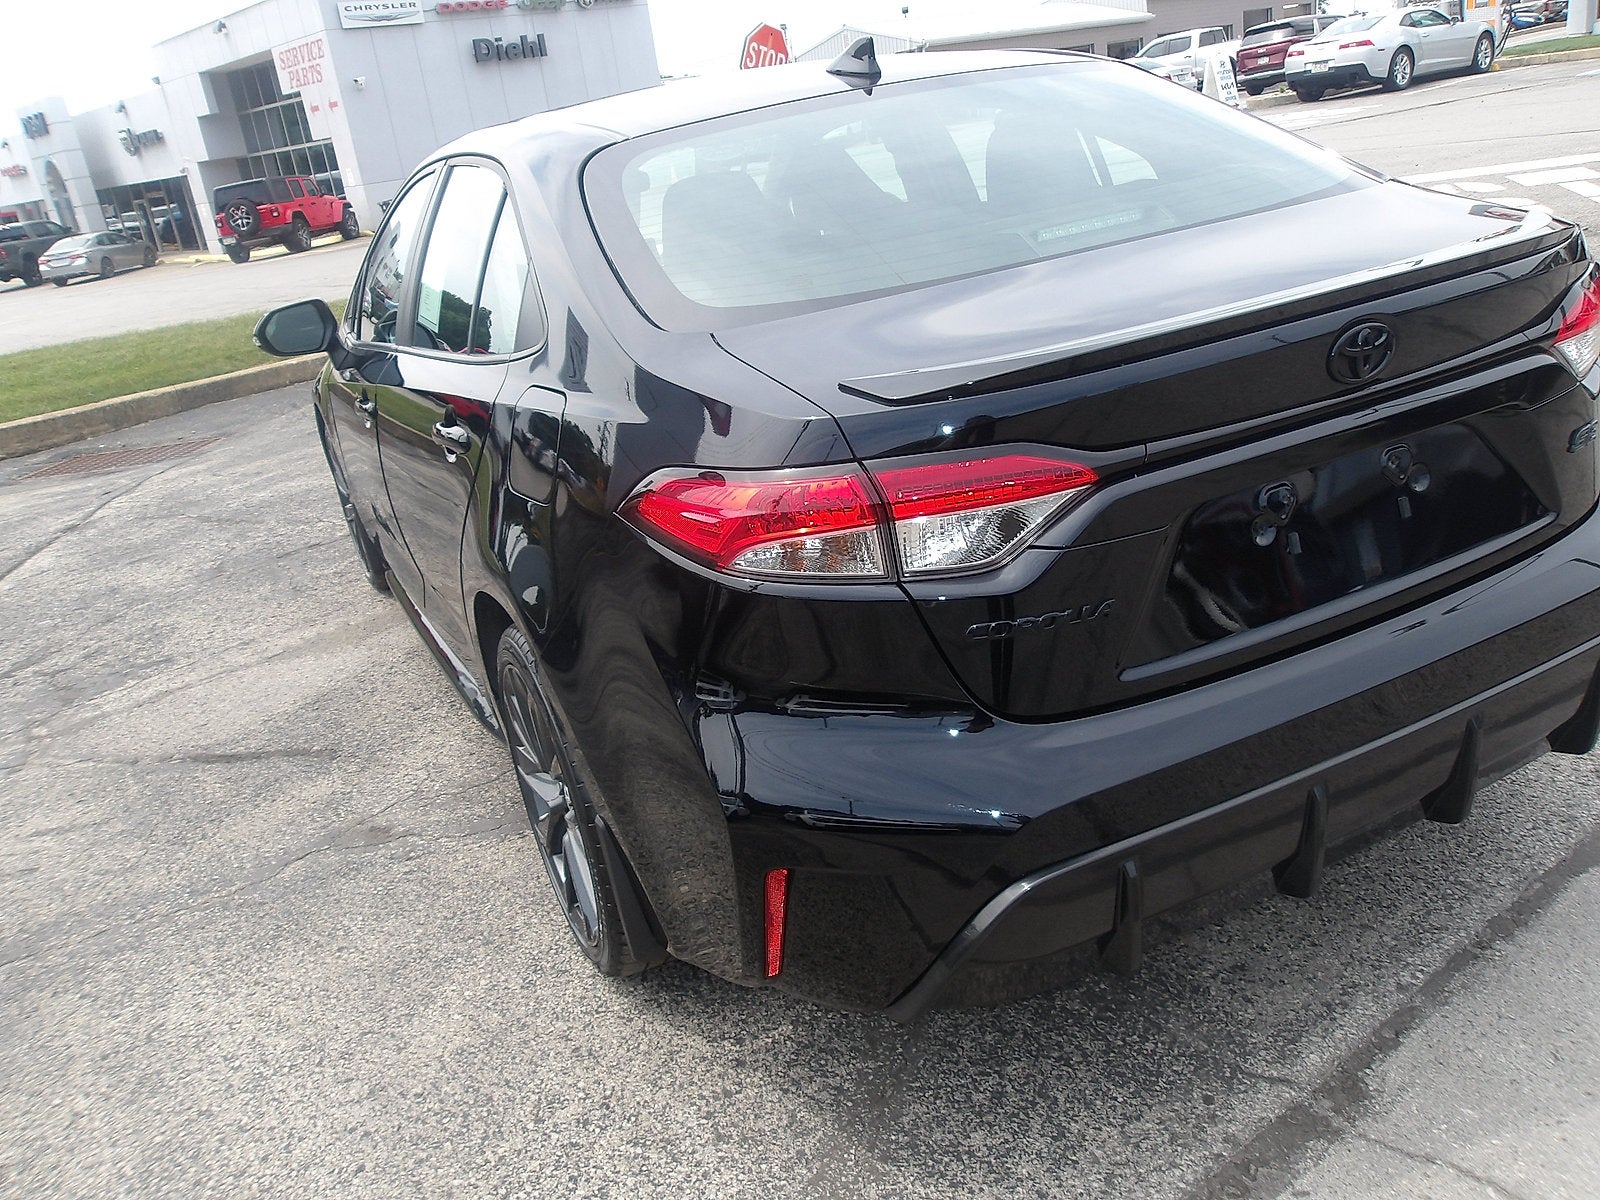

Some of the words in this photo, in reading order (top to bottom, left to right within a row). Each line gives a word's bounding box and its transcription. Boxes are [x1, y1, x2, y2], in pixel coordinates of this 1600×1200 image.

[344, 2, 417, 12] CHRYSLER
[438, 0, 508, 13] DODGE
[279, 38, 325, 70] SERVICE
[472, 33, 548, 63] Diehl
[288, 64, 323, 89] PARTS
